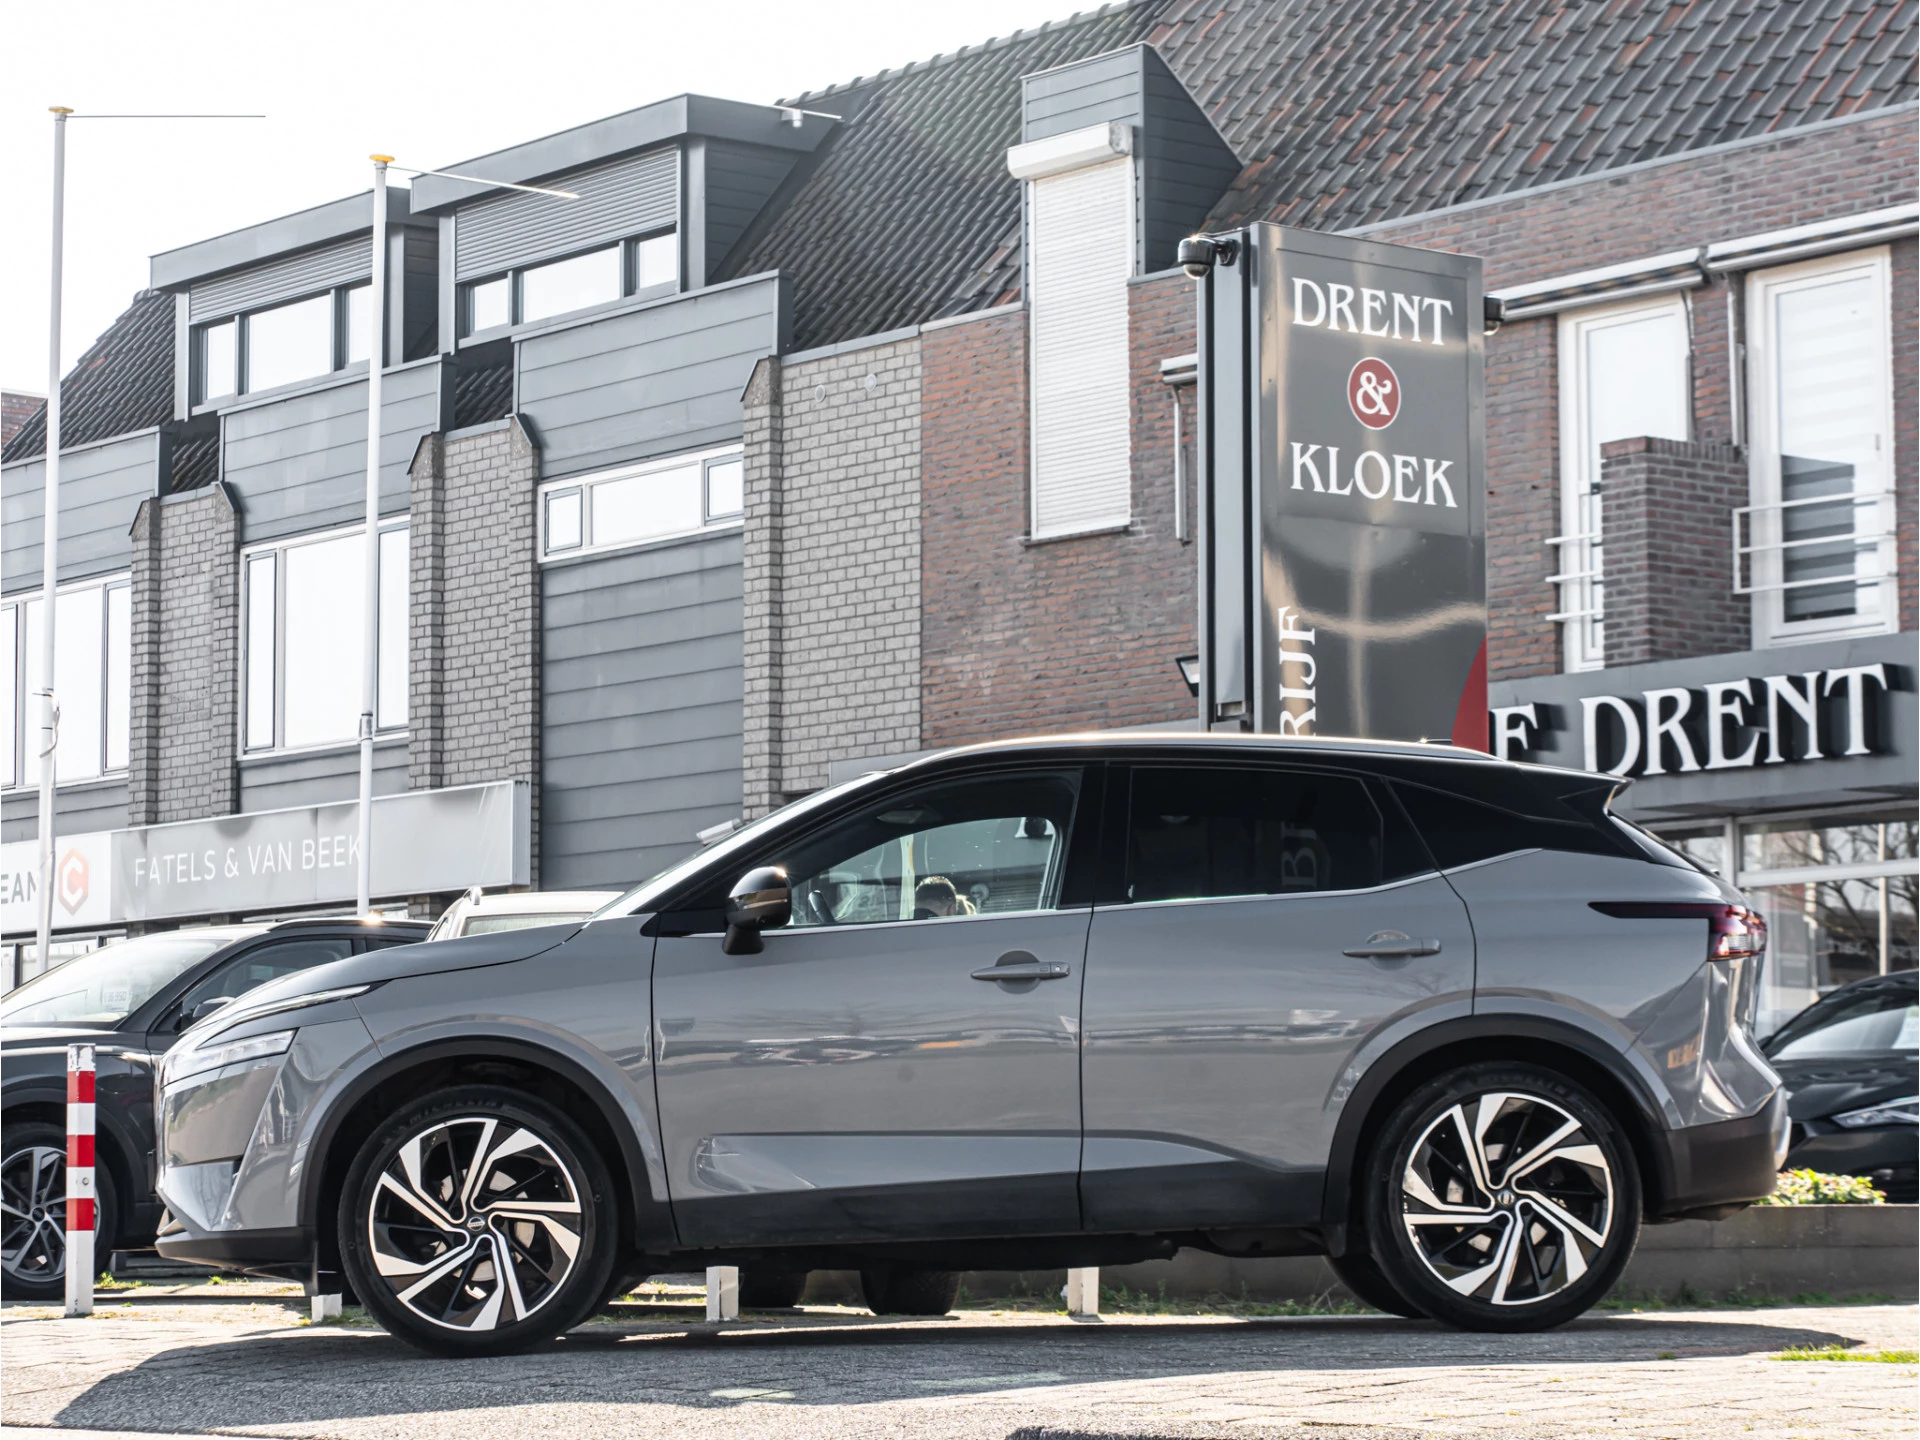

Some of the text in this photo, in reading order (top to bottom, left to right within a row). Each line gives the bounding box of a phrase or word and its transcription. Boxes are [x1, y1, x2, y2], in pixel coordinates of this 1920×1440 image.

[1291, 277, 1453, 345] DRENT
[1355, 371, 1392, 416] &
[1290, 441, 1458, 508] KLOEK
[1579, 662, 1889, 777] DRENT
[135, 834, 361, 888] FATELS & VAN BEEK
